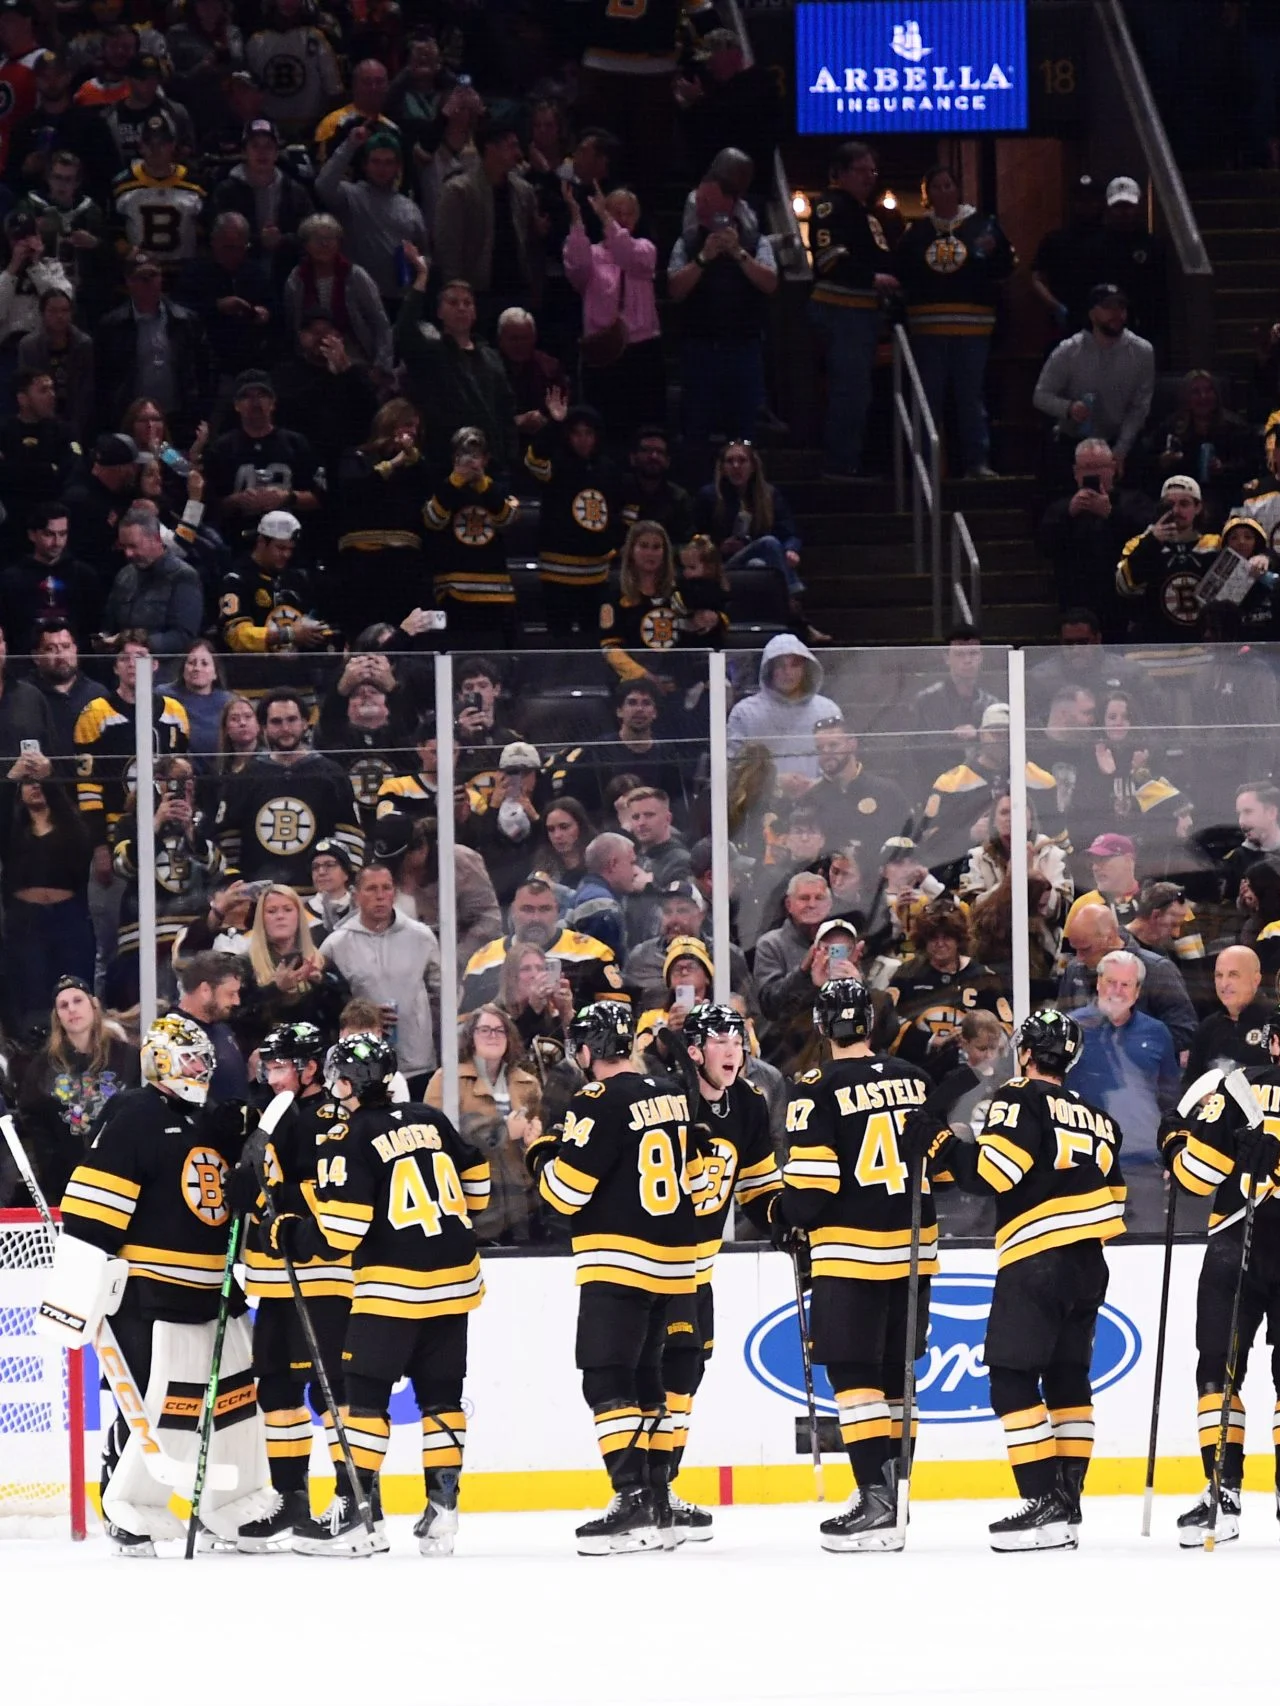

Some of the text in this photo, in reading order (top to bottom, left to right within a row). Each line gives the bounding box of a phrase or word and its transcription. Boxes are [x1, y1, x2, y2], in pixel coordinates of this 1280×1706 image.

[809, 63, 1013, 93] ARBELLA
[1040, 60, 1076, 94] 18
[837, 96, 986, 113] INSURANCE
[140, 205, 180, 252] B
[274, 810, 298, 836] B
[962, 987, 978, 1008] C
[988, 1101, 1021, 1129] 51
[26, 1175, 51, 1222] TACKS
[196, 1163, 223, 1208] B
[42, 1304, 85, 1330] TRUE
[100, 1346, 161, 1454] CCM
[165, 1402, 198, 1412] CCM
[217, 1390, 251, 1409] CCM
